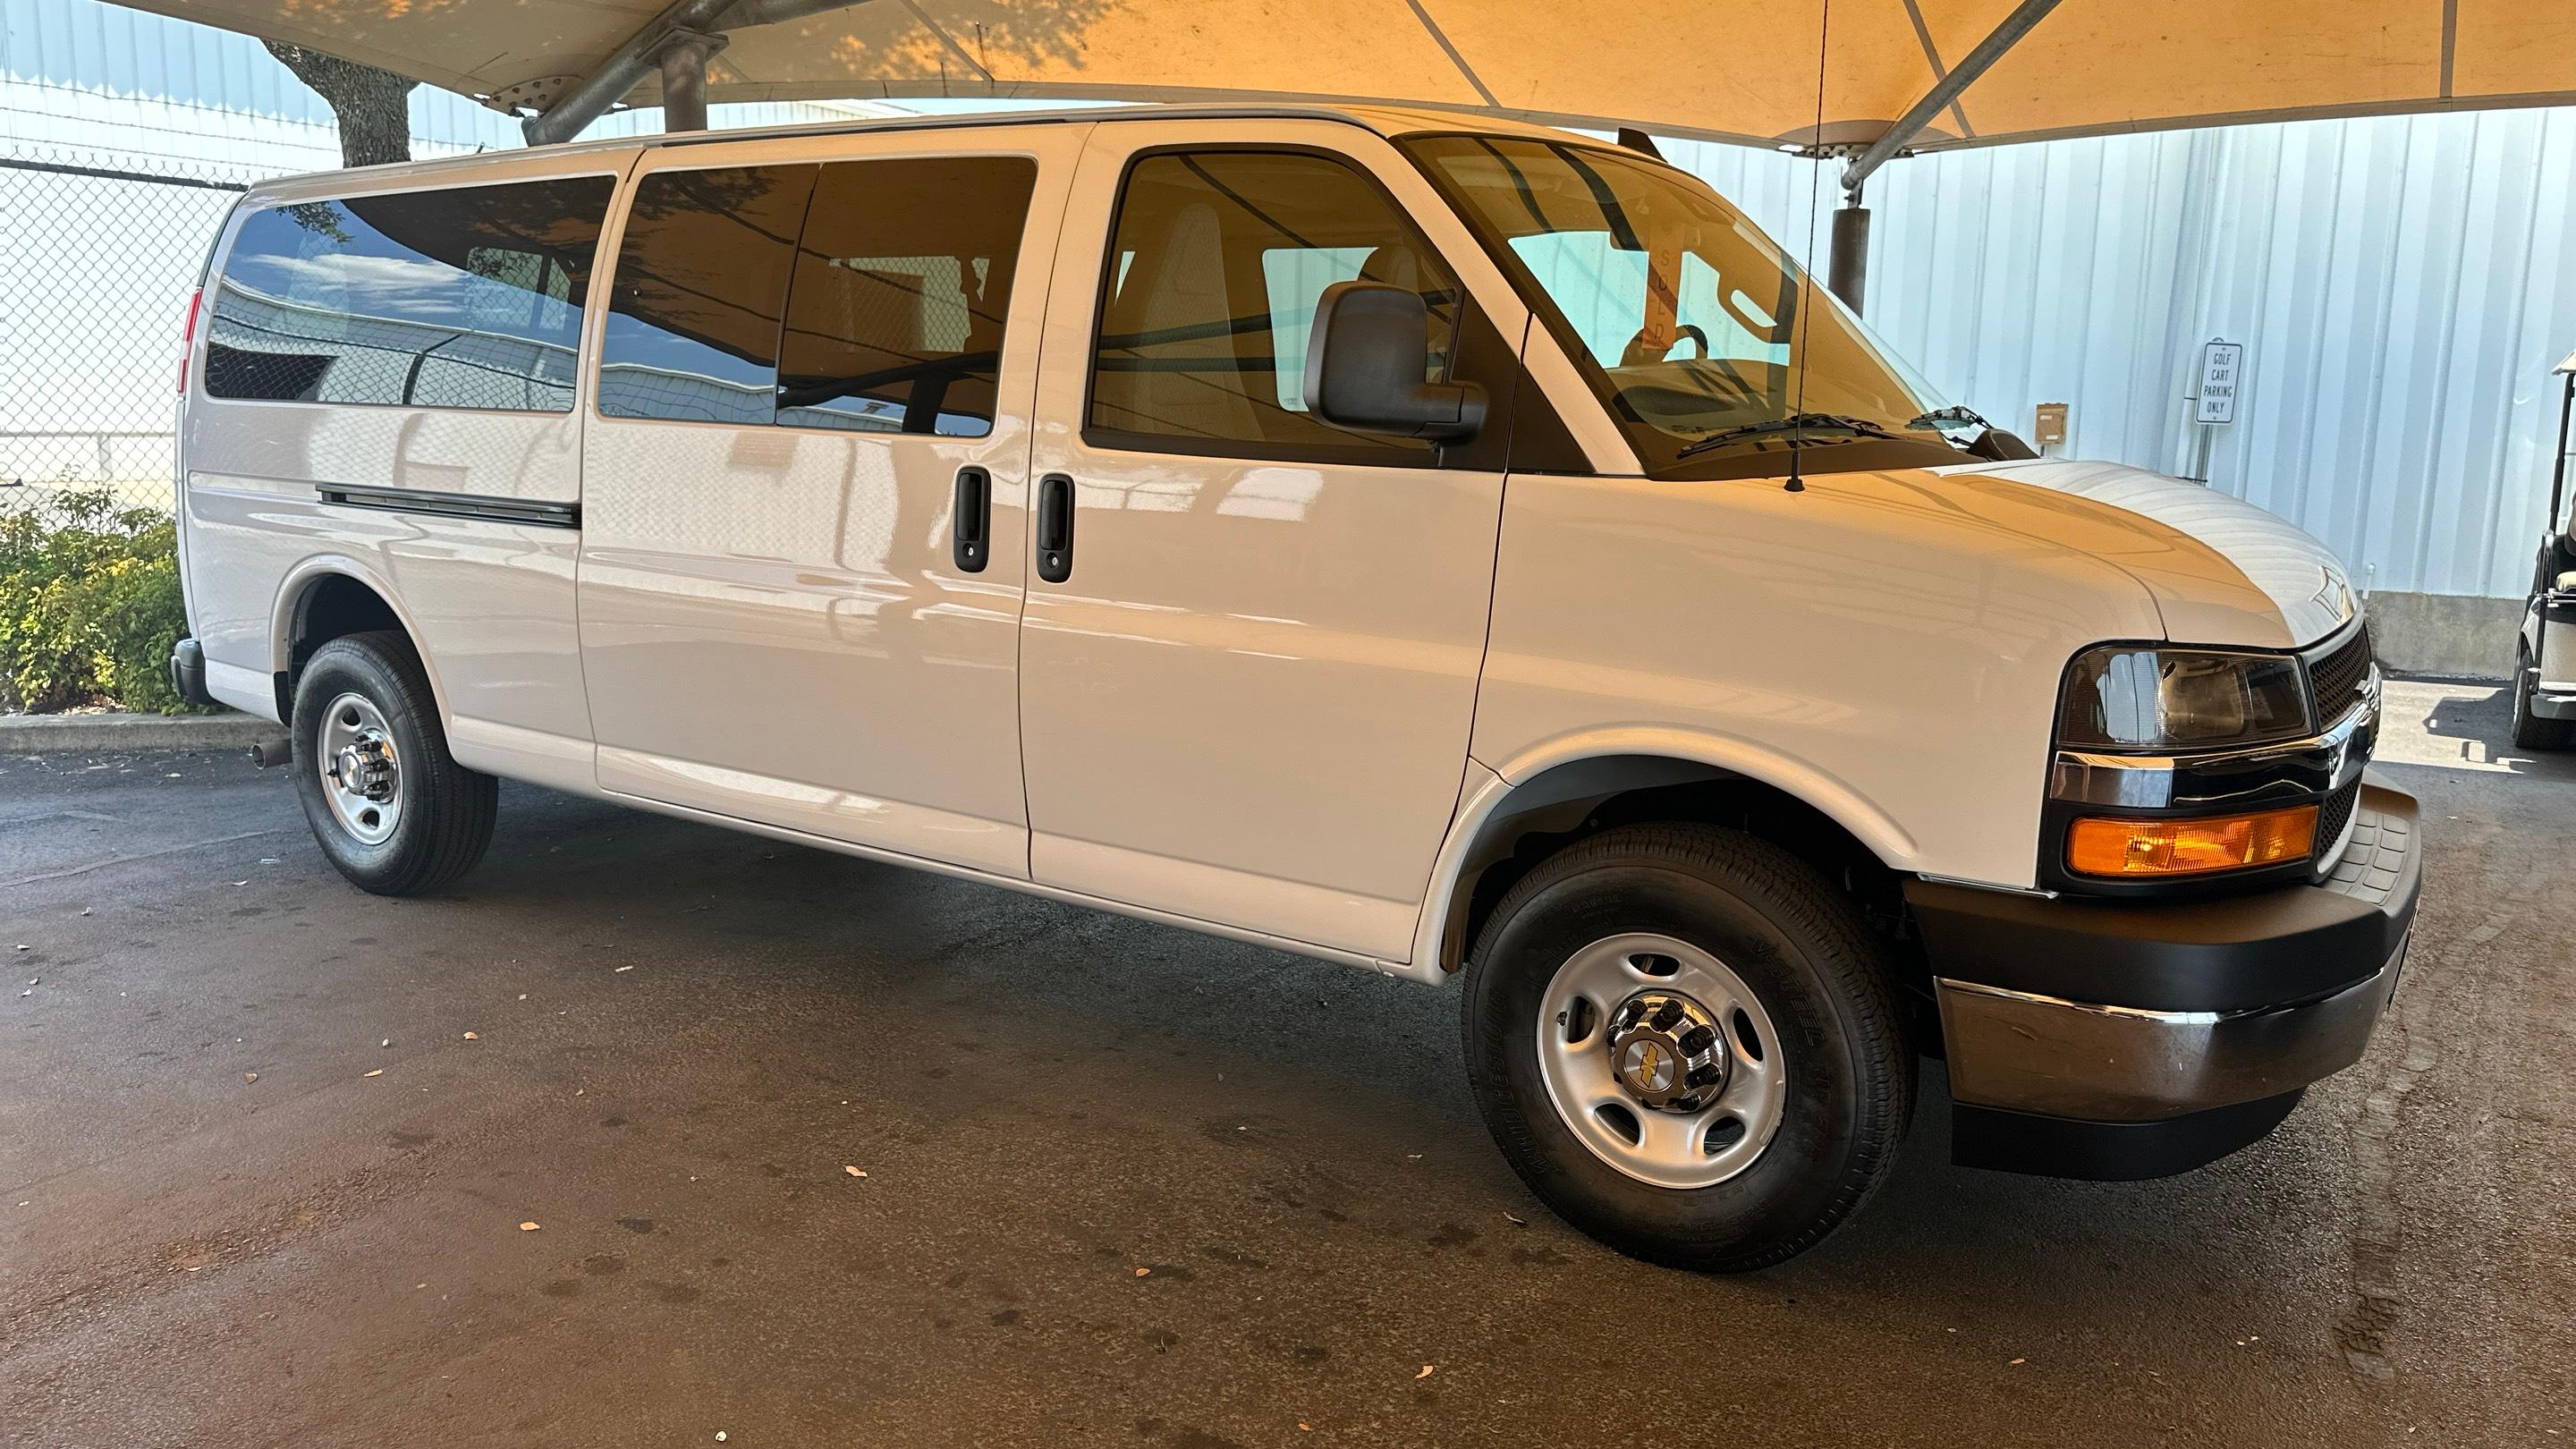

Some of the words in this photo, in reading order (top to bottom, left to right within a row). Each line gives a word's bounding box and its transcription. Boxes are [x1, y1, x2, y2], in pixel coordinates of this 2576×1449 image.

[1655, 250, 1670, 339] SOLD
[2214, 353, 2231, 365] GOLF
[2212, 369, 2229, 381] CART
[2204, 386, 2232, 397] PARKING
[2207, 402, 2224, 413] ONLY
